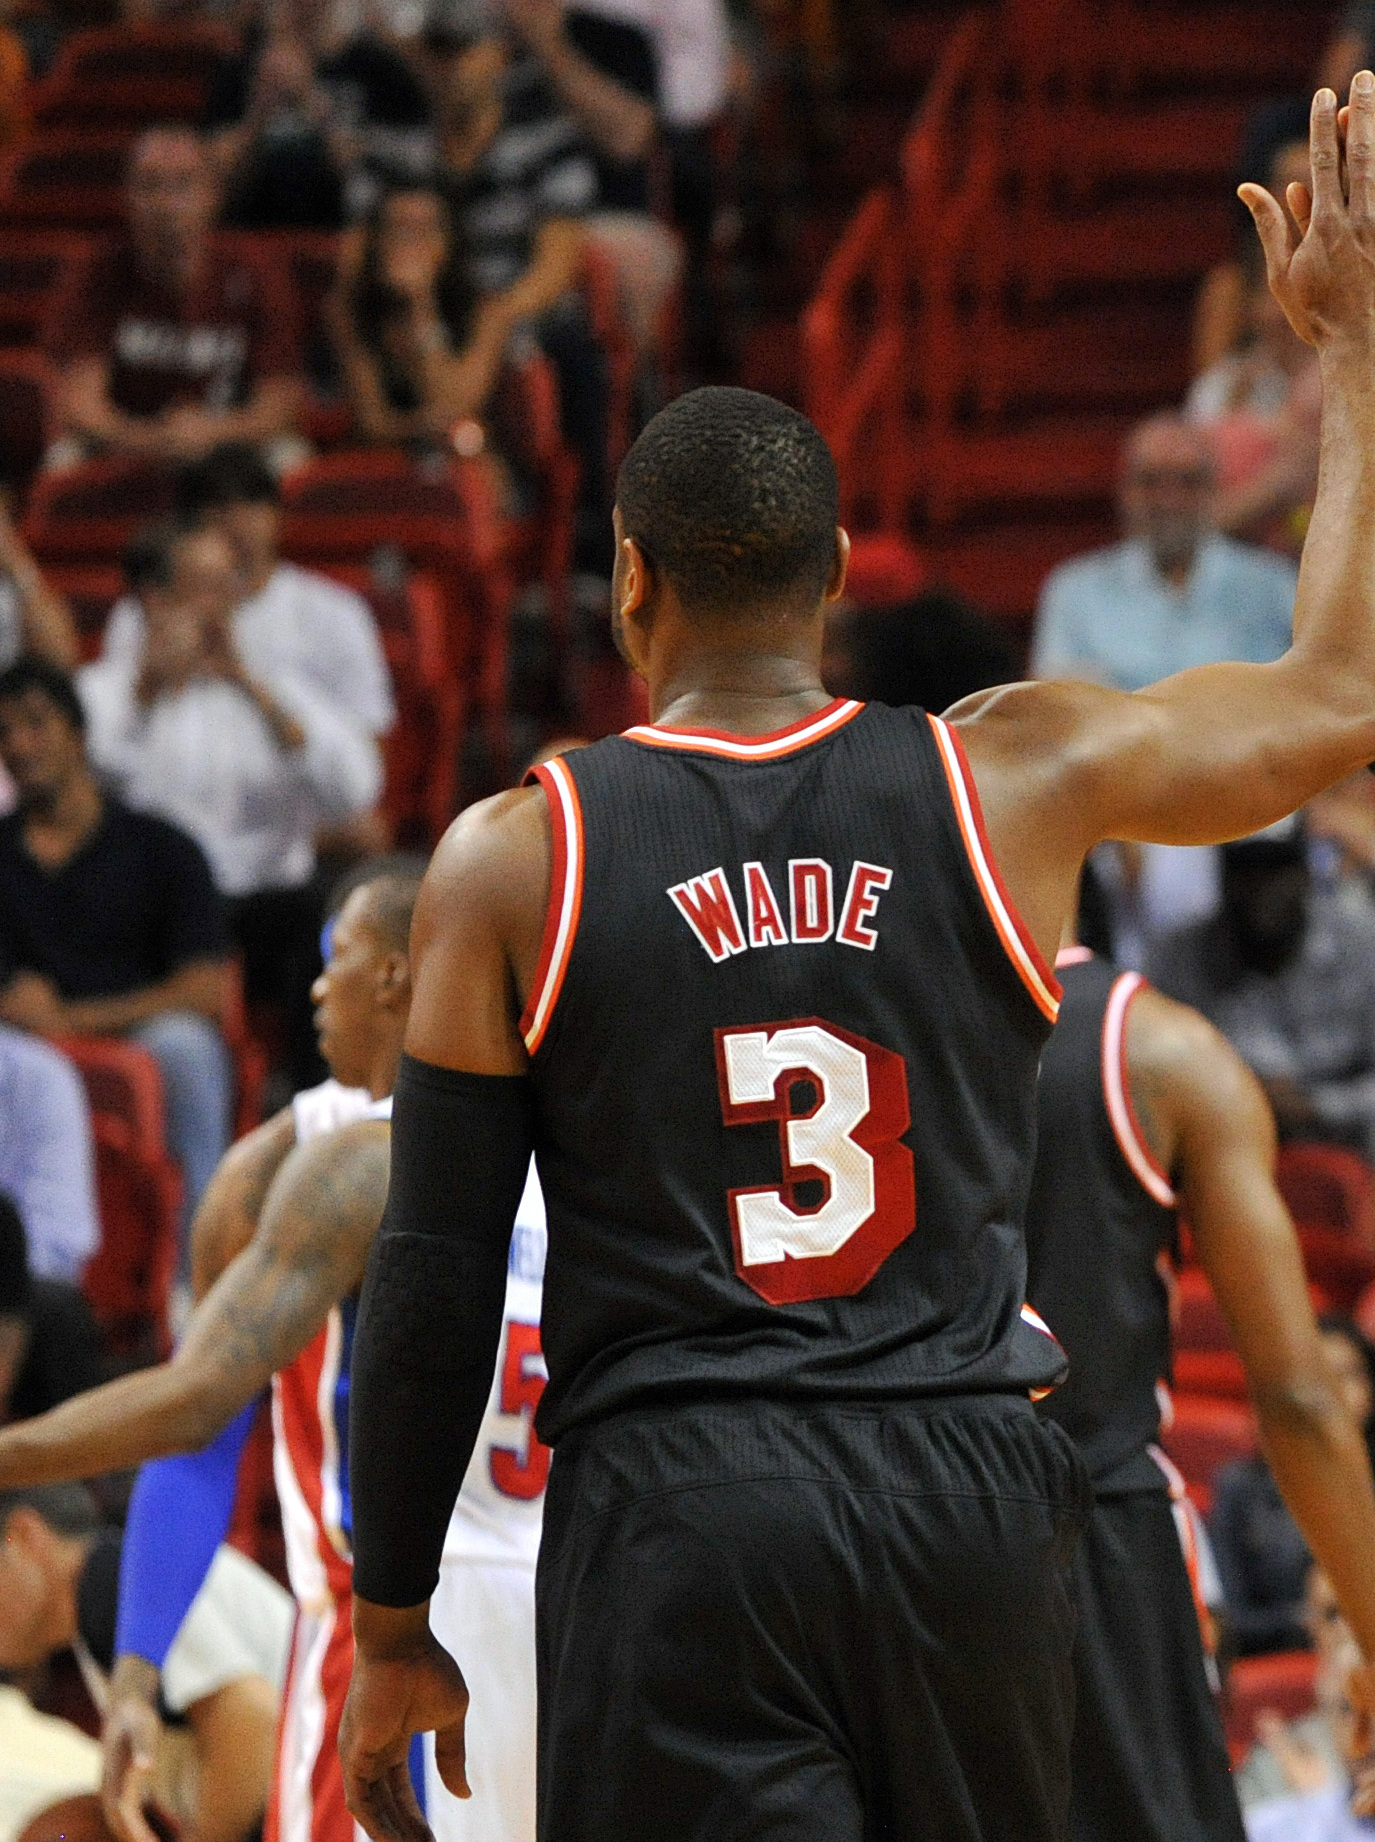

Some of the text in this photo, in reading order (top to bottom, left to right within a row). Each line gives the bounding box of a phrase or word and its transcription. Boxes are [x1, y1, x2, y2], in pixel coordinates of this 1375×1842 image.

[667, 858, 893, 963] WADE
[713, 1015, 917, 1306] 3
[490, 1321, 553, 1500] 5
